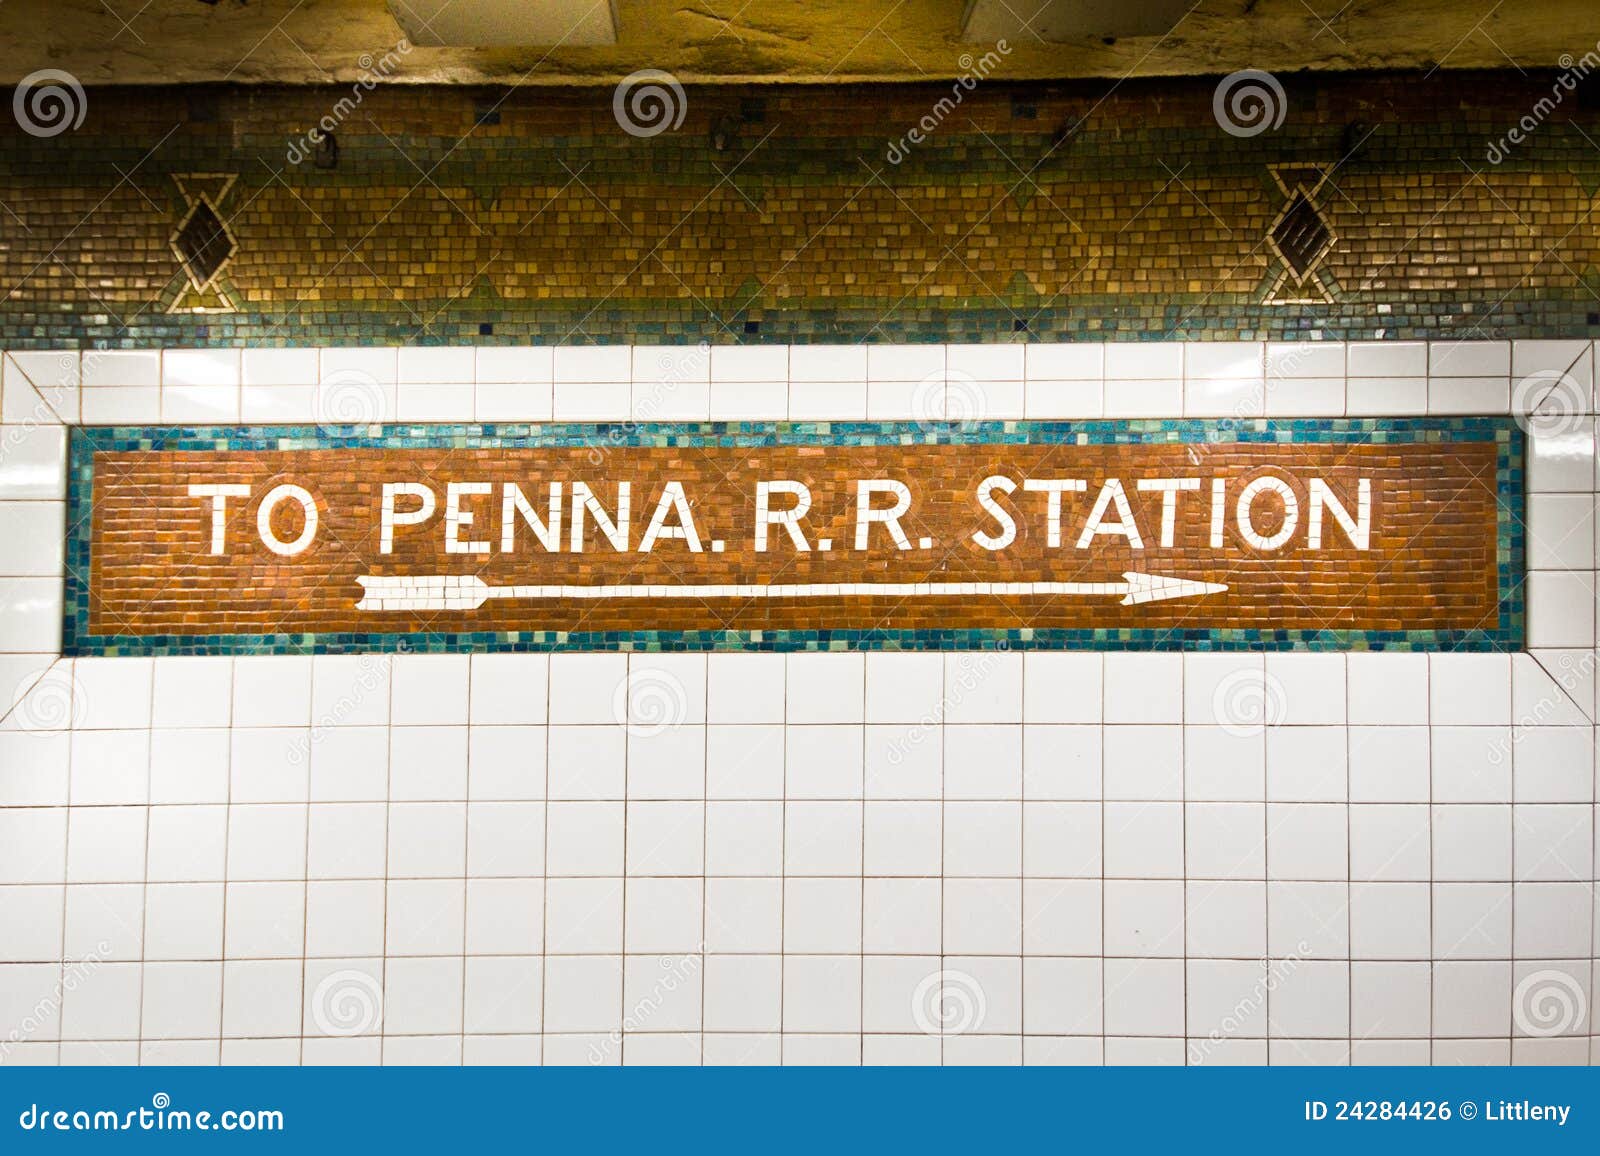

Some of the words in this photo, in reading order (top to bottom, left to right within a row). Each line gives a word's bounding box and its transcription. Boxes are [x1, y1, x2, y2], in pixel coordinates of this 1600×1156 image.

[188, 483, 319, 557] TO
[379, 480, 725, 556] PENNA.
[971, 475, 1372, 552] STATION
